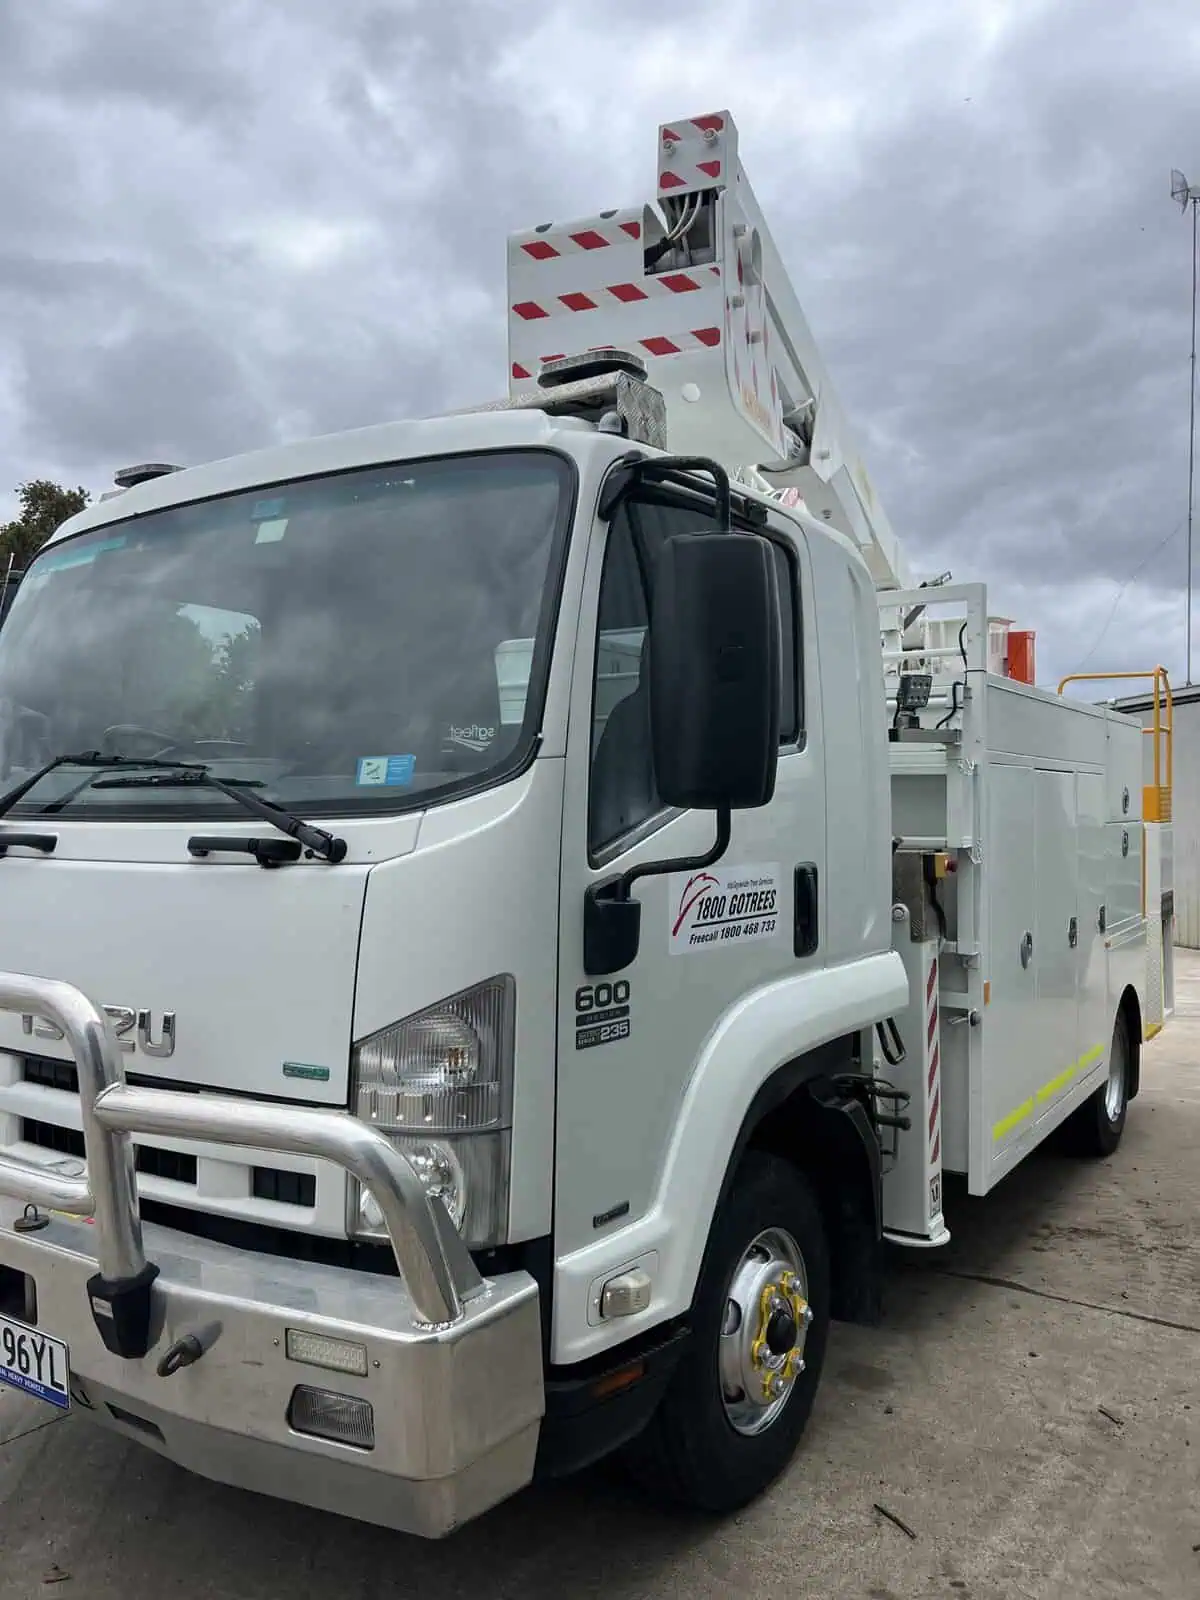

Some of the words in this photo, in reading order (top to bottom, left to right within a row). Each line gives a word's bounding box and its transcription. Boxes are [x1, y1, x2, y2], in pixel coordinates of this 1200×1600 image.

[697, 895, 726, 920] 1800
[729, 889, 777, 915] GOTREES
[690, 931, 718, 944] Freecall
[720, 925, 741, 939] 1800
[761, 919, 776, 933] 733
[576, 980, 630, 1012] 600
[600, 1022, 628, 1040] 235
